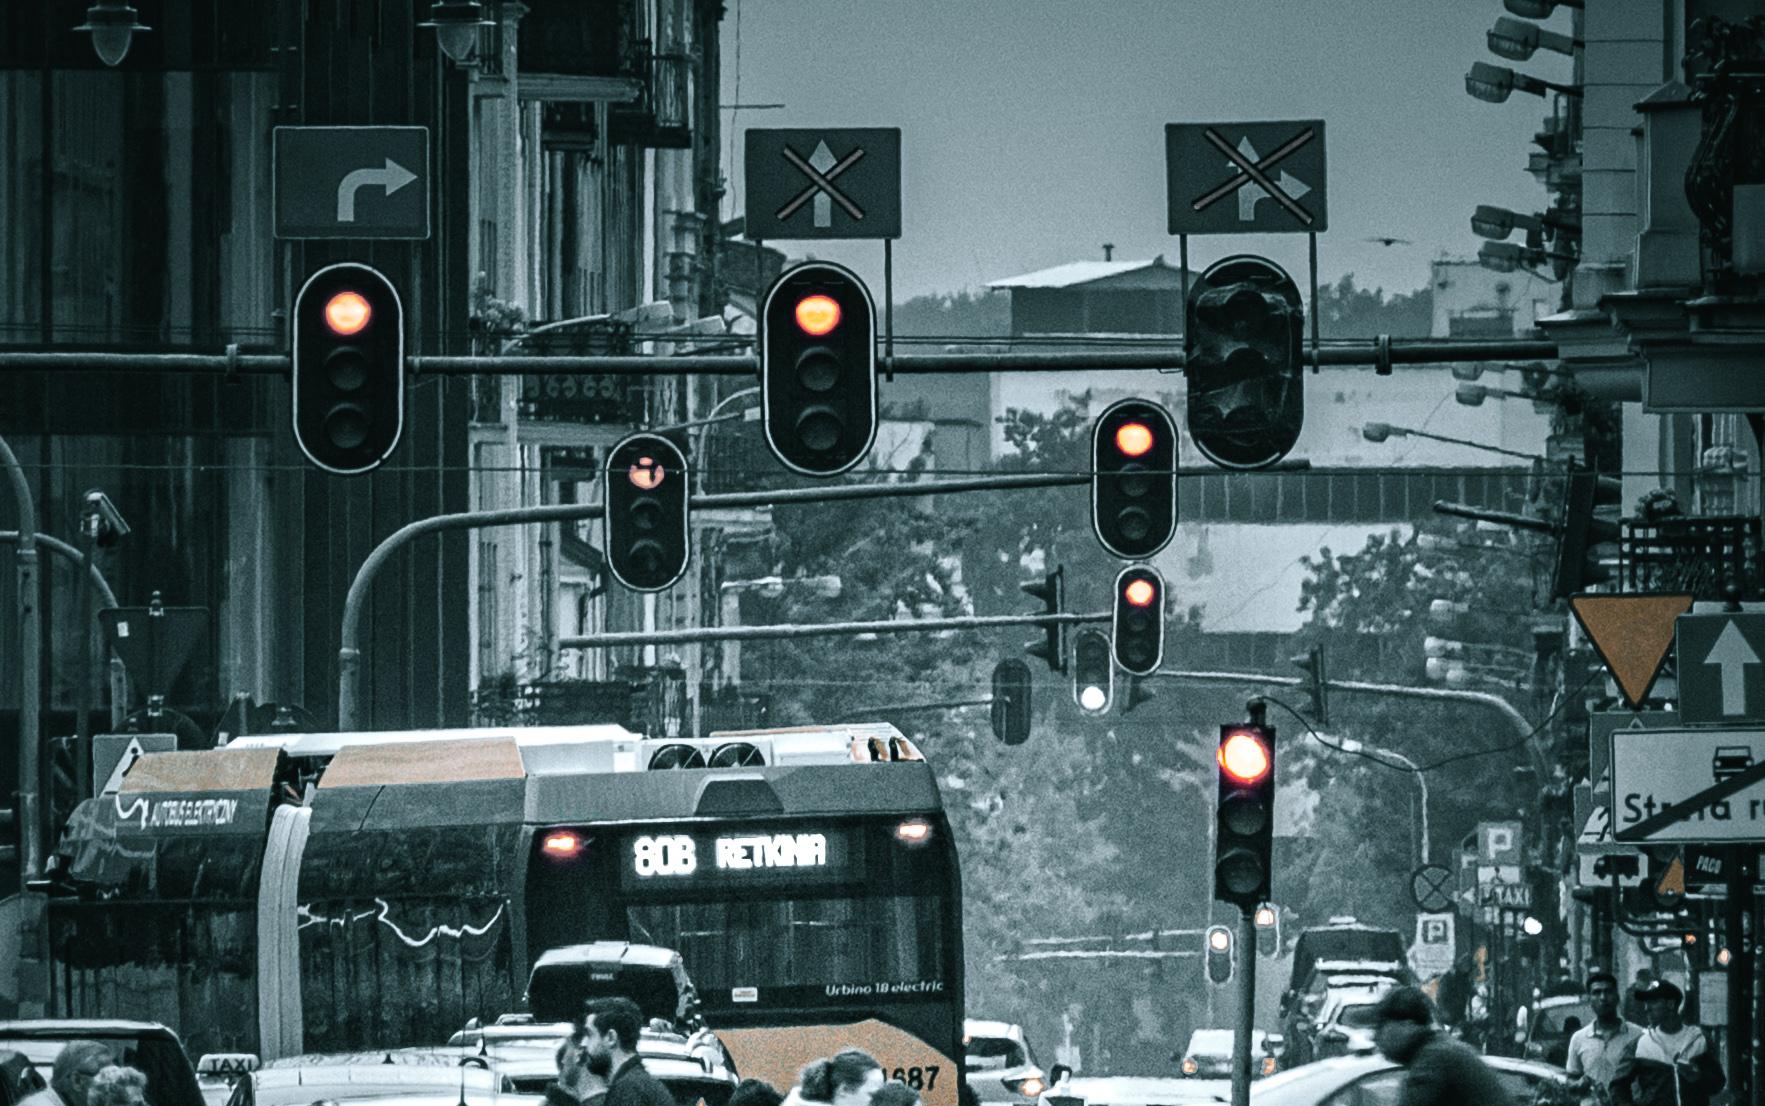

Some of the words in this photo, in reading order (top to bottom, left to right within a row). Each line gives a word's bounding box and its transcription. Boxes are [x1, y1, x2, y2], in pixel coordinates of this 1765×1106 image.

[825, 984, 872, 996] Urbino
[891, 981, 944, 992] electric
[211, 1058, 252, 1071] TAXI
